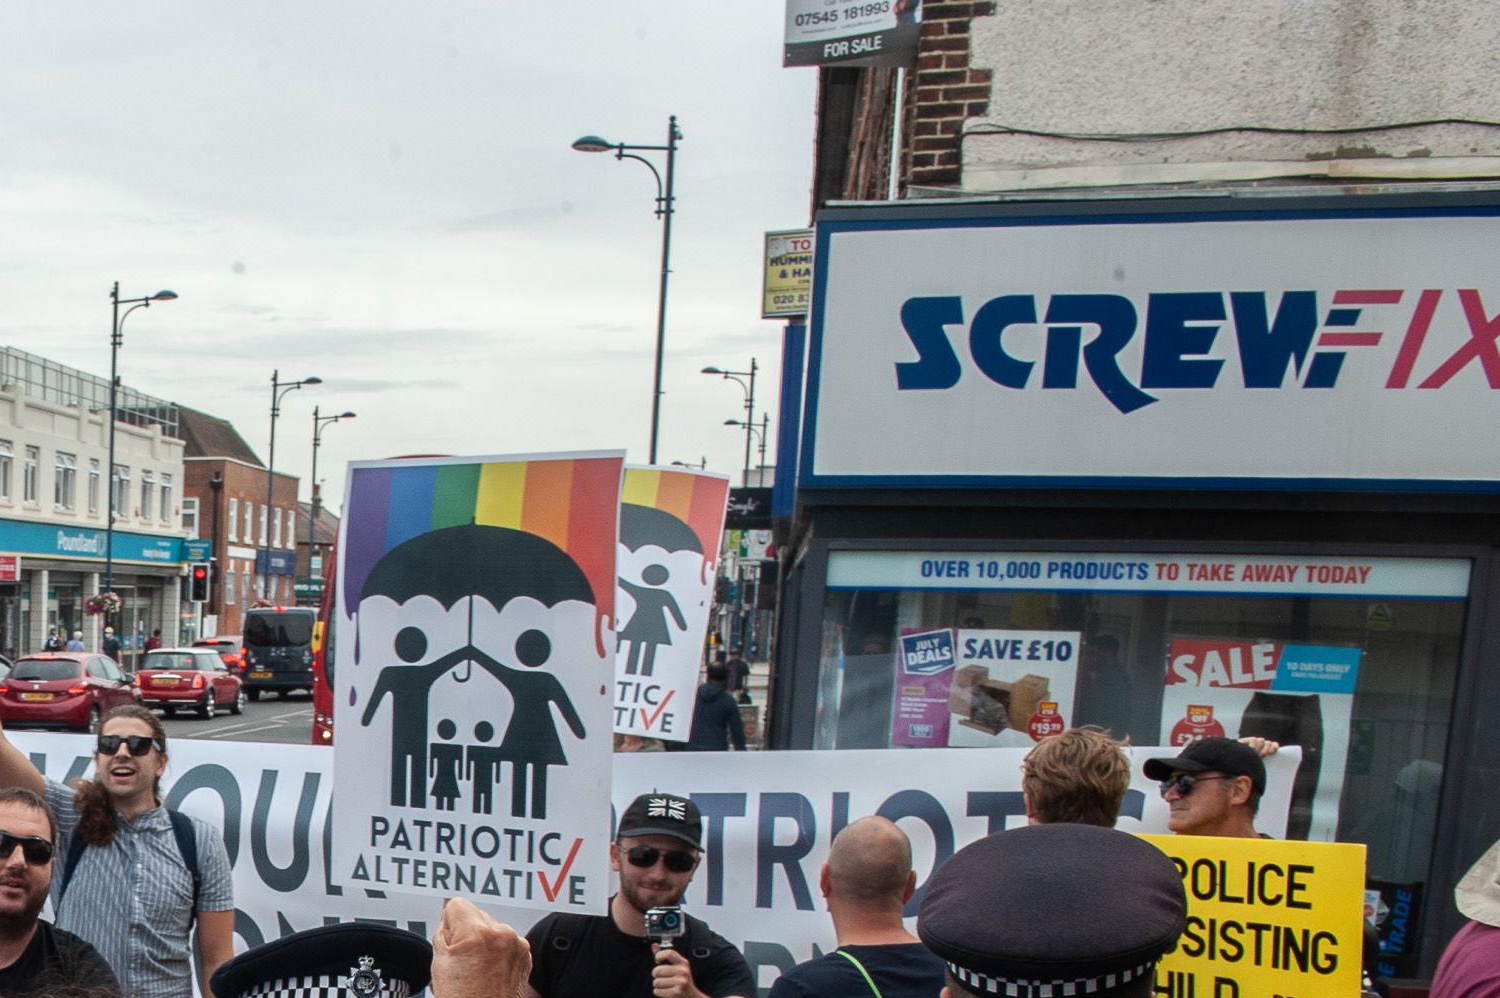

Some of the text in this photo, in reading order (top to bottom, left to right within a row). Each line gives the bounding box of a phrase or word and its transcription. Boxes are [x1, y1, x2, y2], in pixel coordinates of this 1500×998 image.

[794, 9, 838, 27] 07545
[843, 1, 890, 20] 181993
[823, 35, 882, 58] FOR SALE
[790, 239, 811, 251] TO
[769, 255, 812, 267] HUMM
[772, 295, 794, 305] 020
[895, 288, 1500, 415] SCREWFIX
[57, 530, 101, 552] Poundland
[920, 559, 1371, 585] OVER 10,000 PRODUCTS TO TAKE AWAY TODAY
[907, 646, 951, 666] DEALS
[915, 637, 940, 651] JULY
[963, 637, 1073, 662] SAVE £10
[1172, 643, 1278, 687] SALE
[369, 815, 562, 866] PATRIOTIC
[350, 839, 587, 906] ALTERNATIVE
[1163, 915, 1339, 976] SISTING
